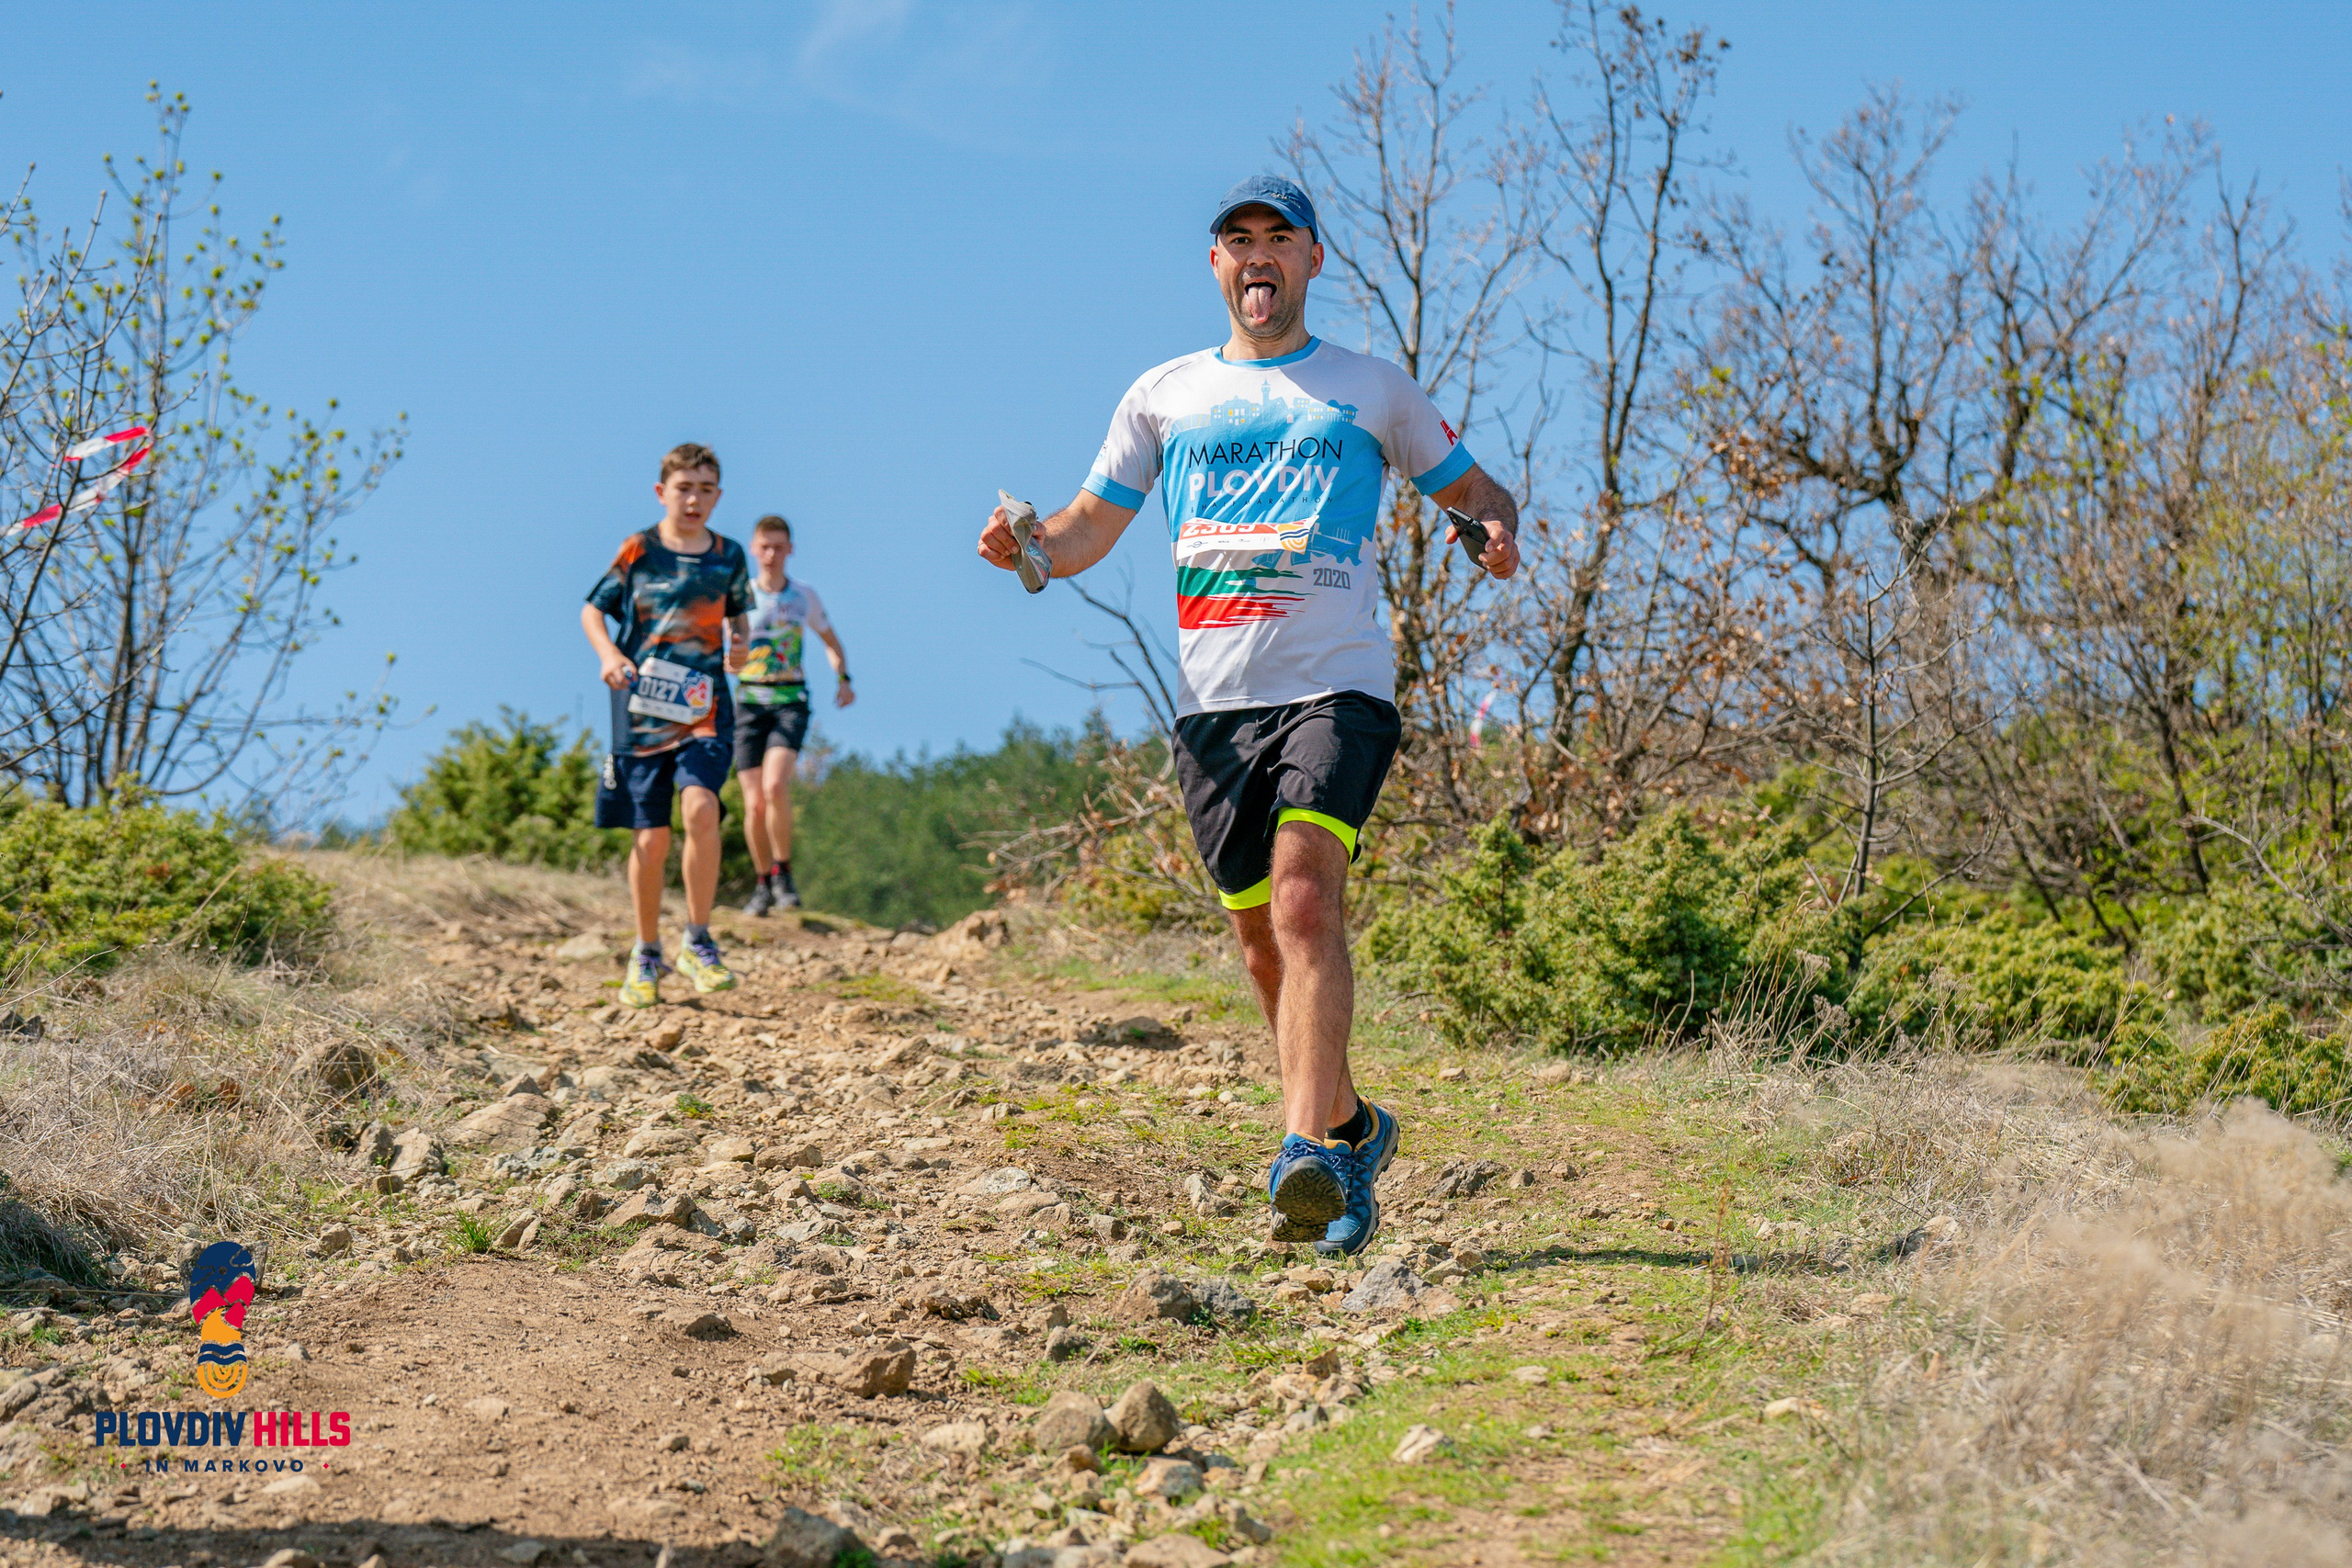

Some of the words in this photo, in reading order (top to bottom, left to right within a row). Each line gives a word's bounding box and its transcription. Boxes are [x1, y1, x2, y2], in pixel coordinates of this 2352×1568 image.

[1188, 436, 1343, 468] MARATHON
[1189, 464, 1340, 501] PLOVDIV
[1244, 497, 1333, 506] MARATHON
[1313, 567, 1351, 590] 2020
[638, 676, 681, 703] 0127
